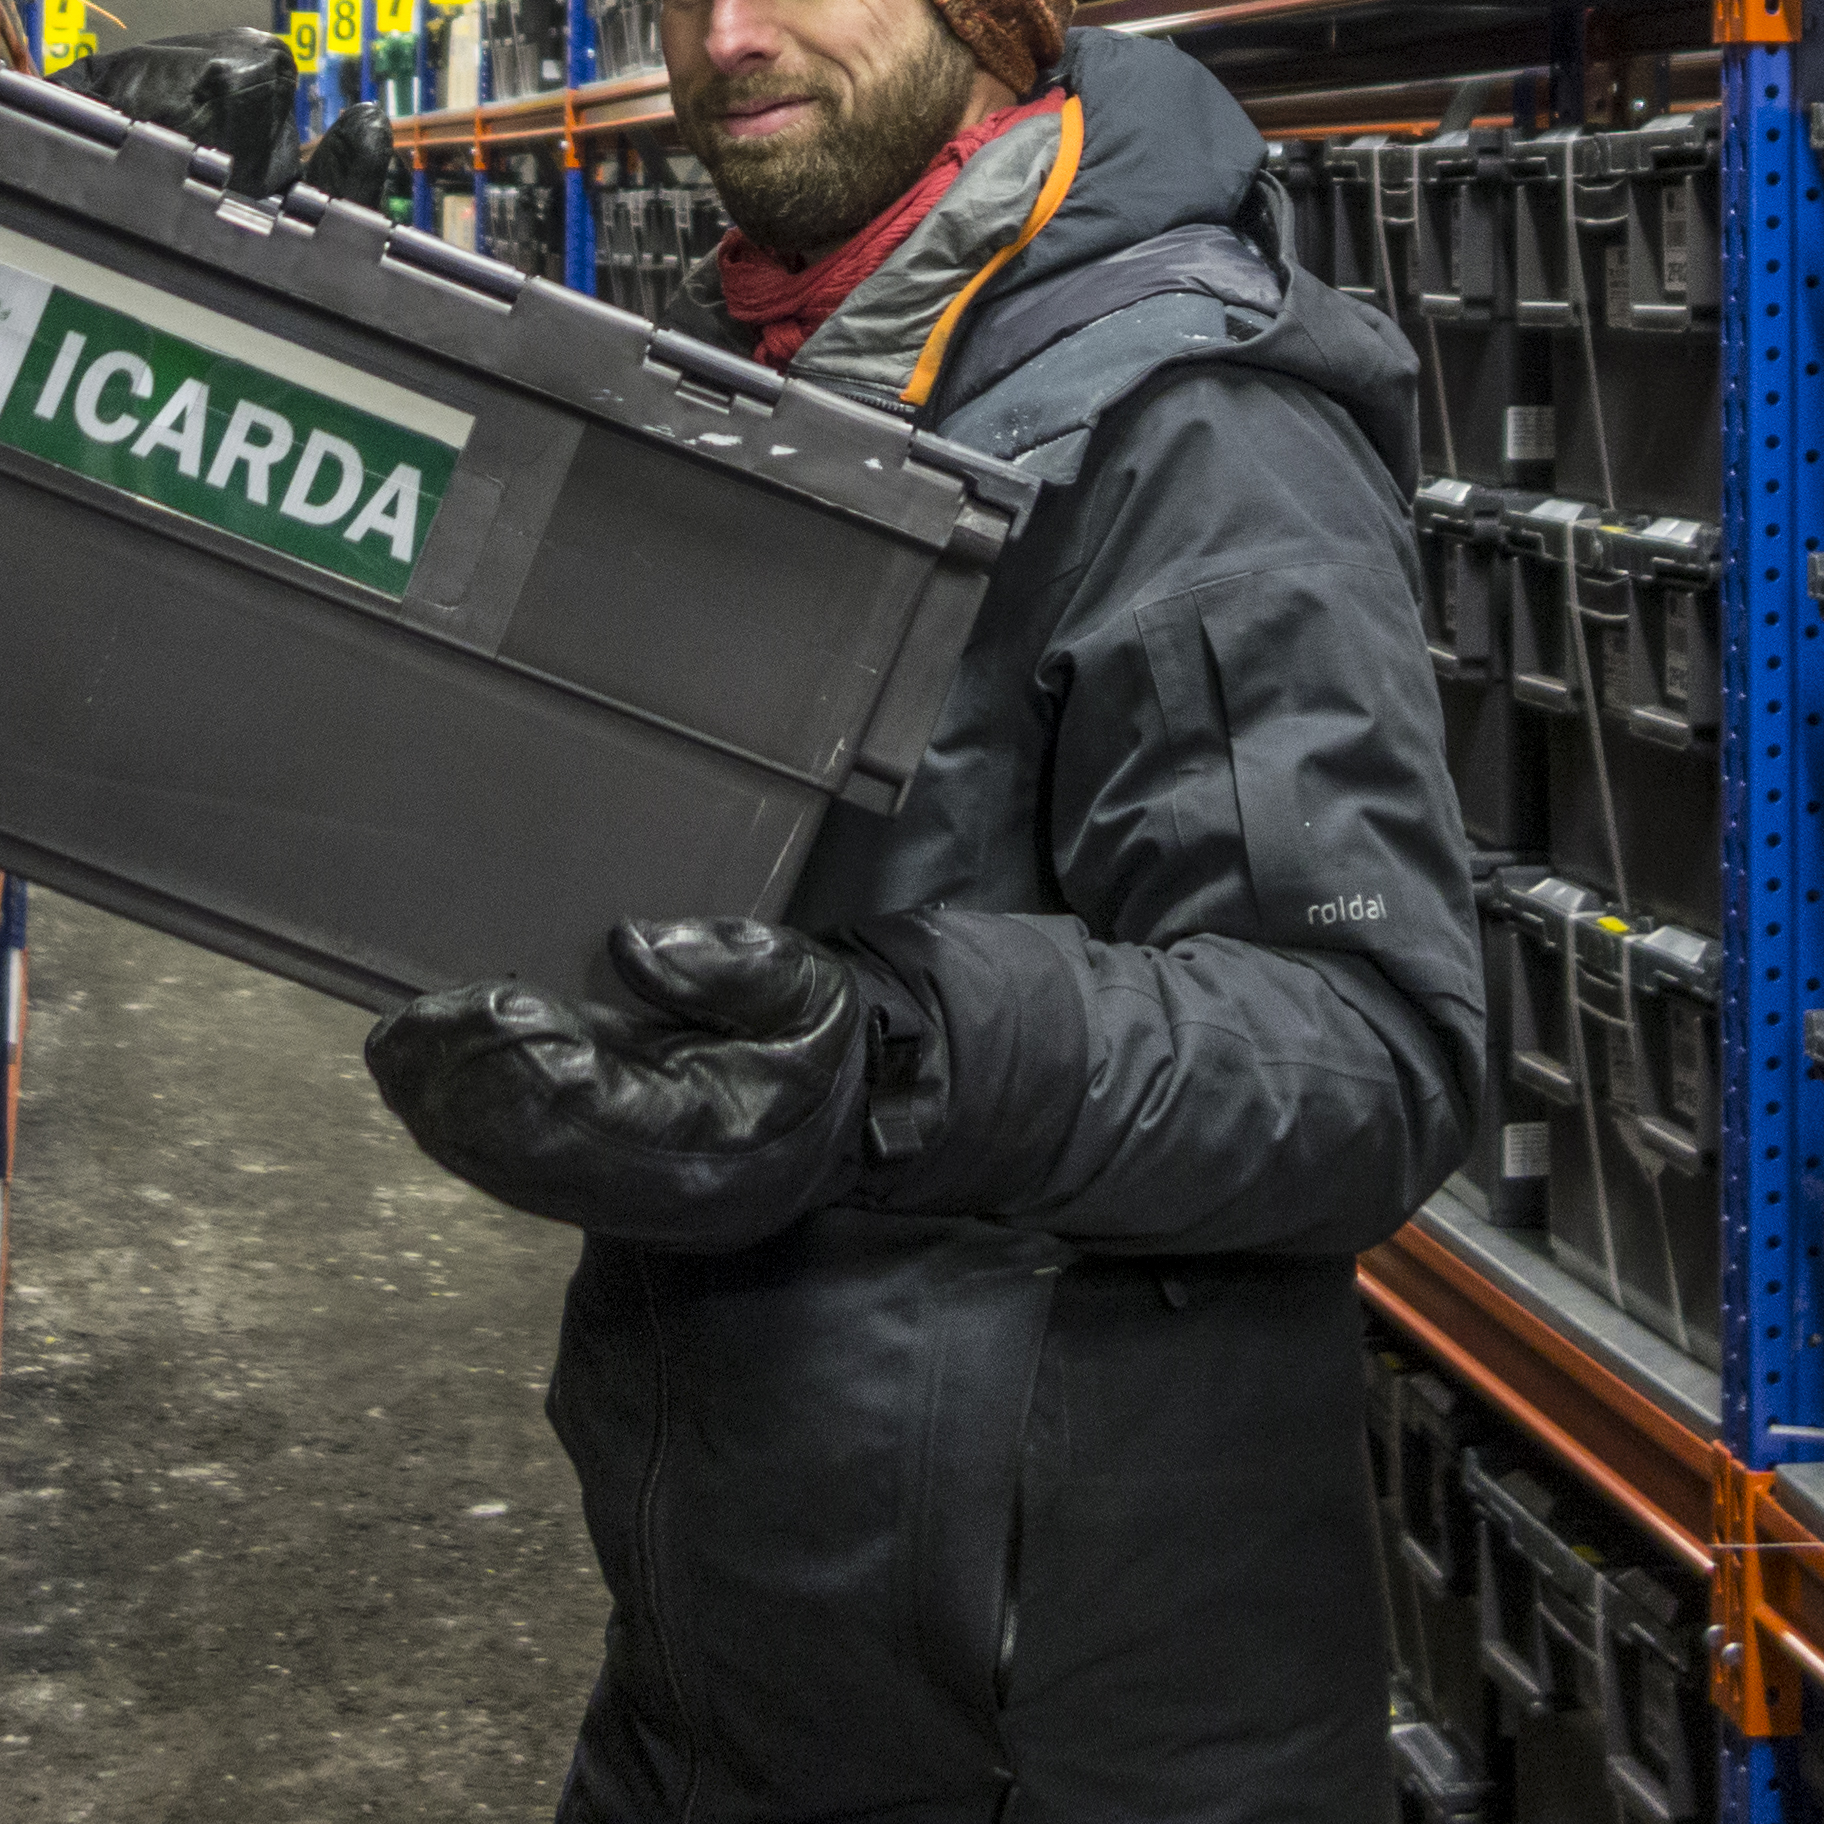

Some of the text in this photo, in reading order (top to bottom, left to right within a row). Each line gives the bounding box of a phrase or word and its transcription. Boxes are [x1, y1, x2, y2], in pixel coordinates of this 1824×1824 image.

[333, 0, 357, 41] 8
[296, 23, 317, 62] 9
[33, 330, 424, 565] ICARDA
